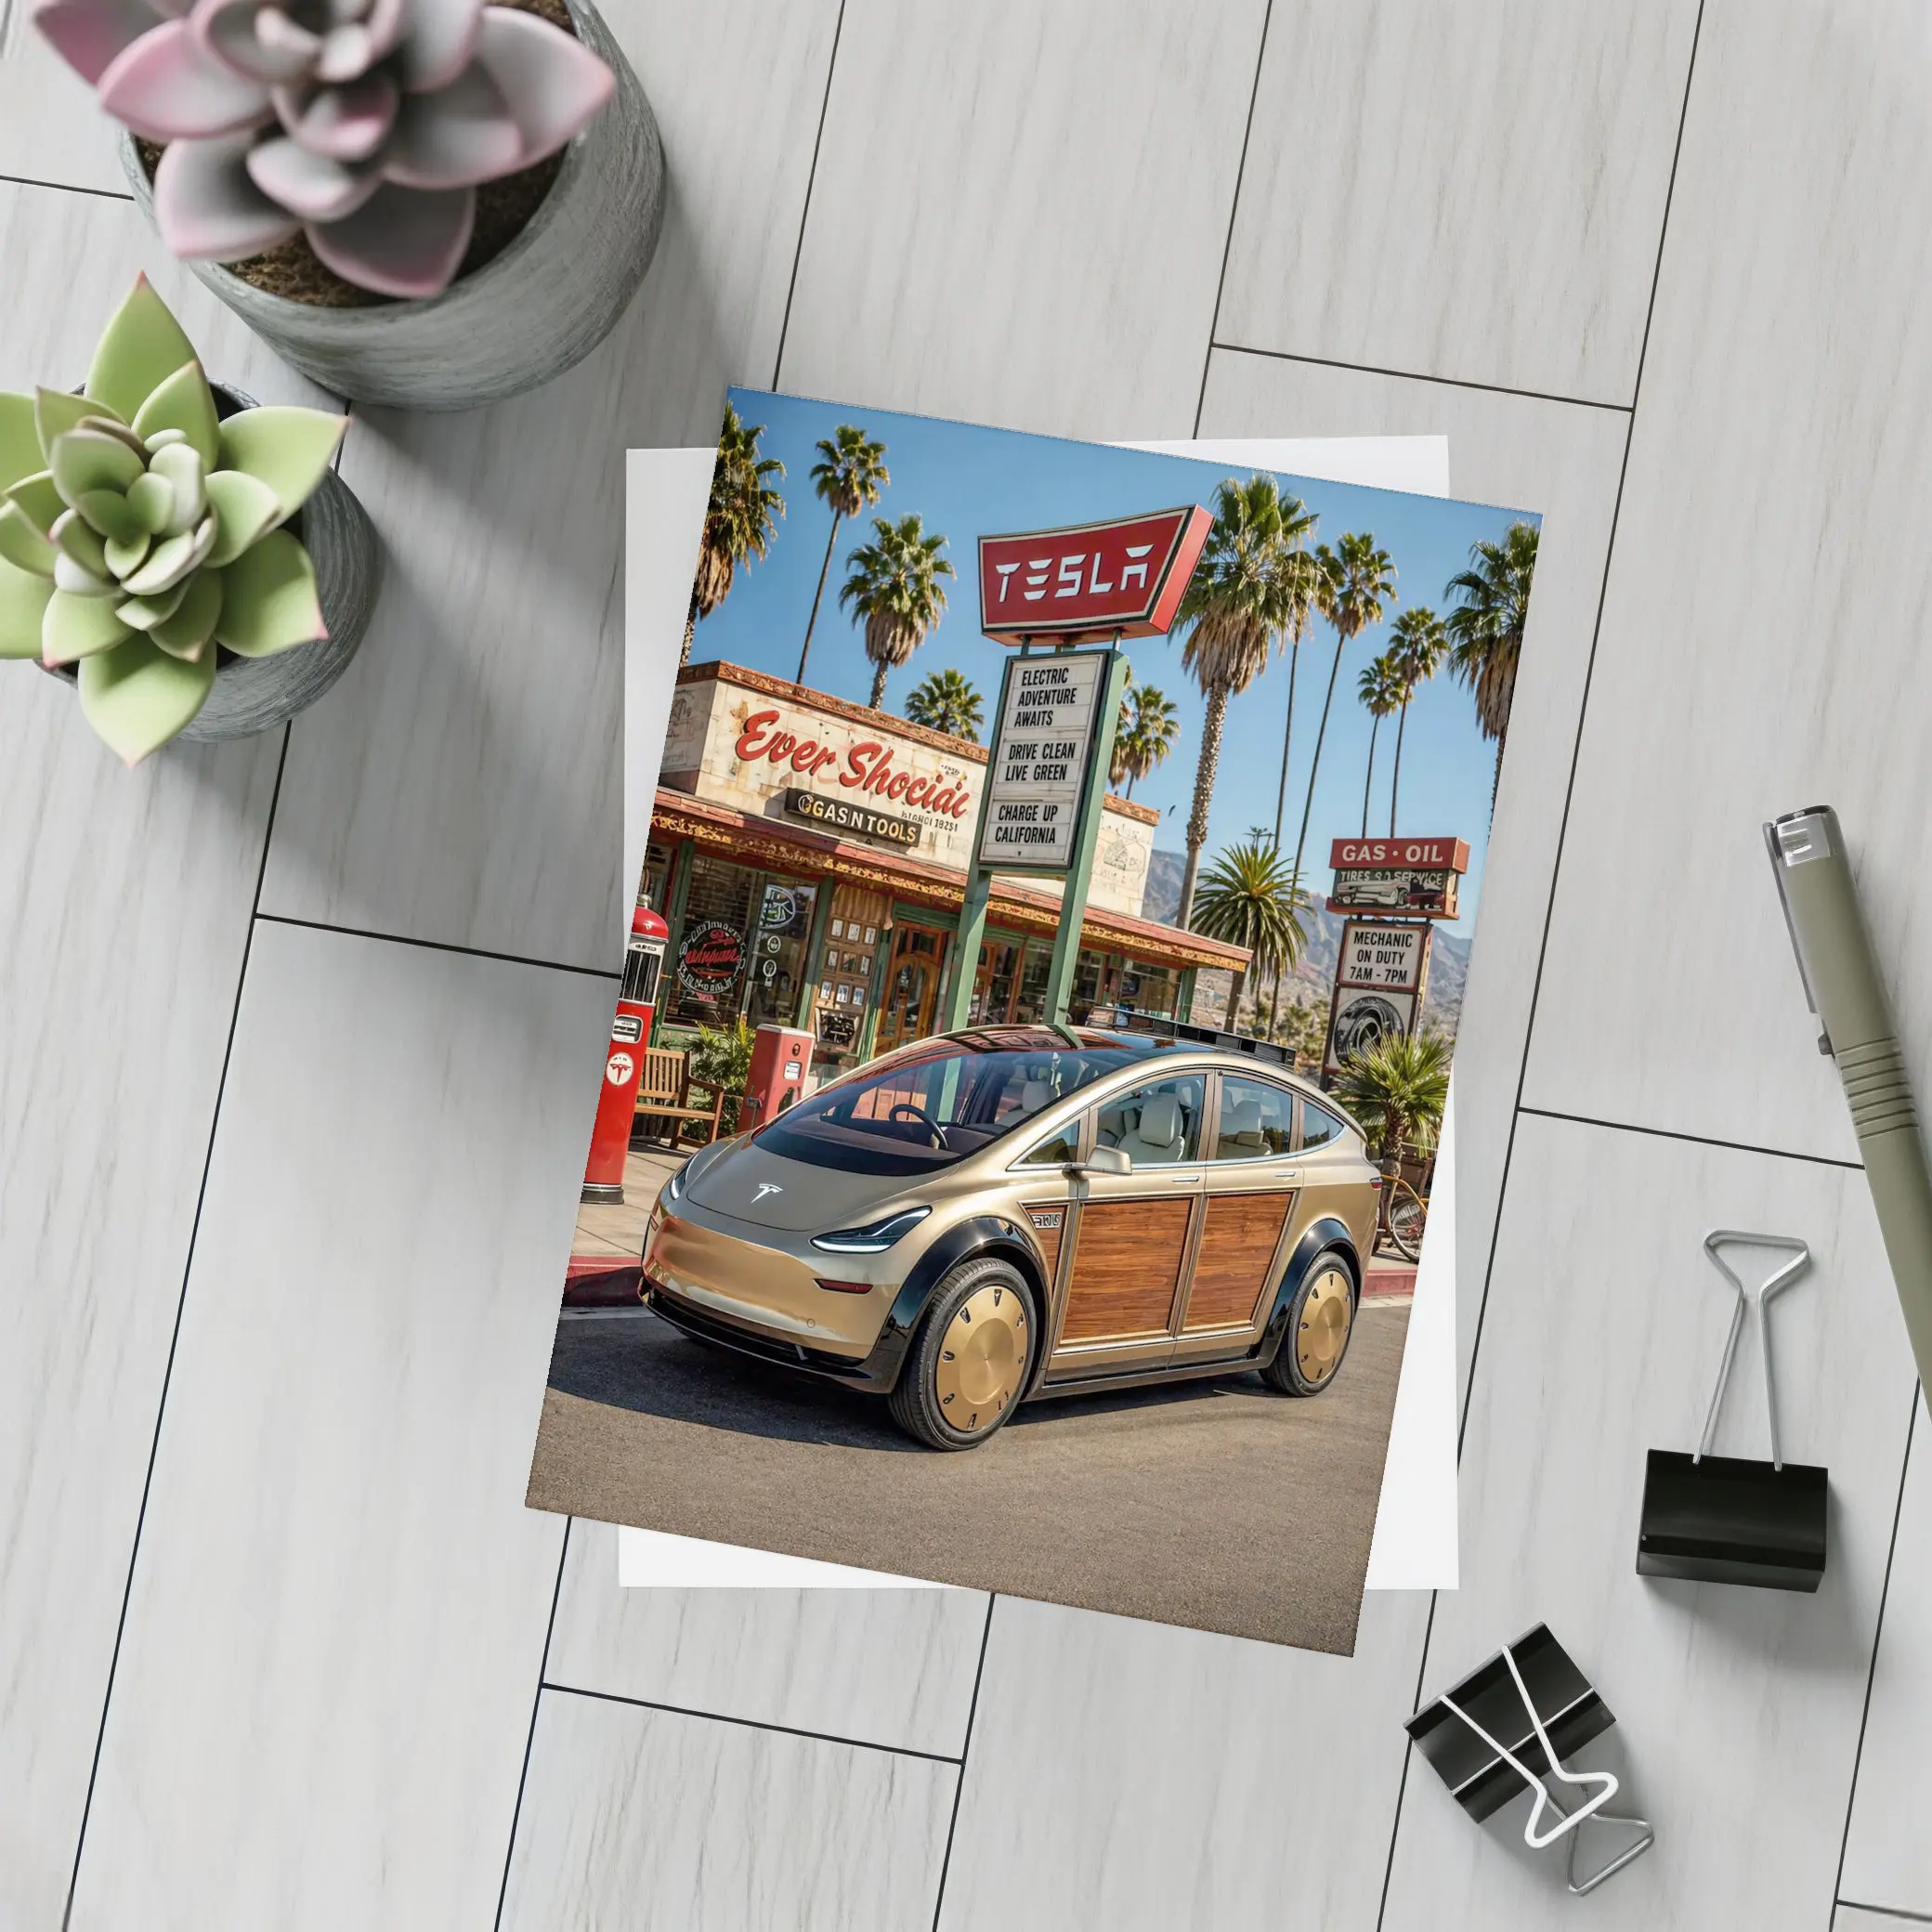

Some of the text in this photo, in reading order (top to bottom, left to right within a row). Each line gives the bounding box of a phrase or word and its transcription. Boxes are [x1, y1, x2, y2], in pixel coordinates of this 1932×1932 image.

[996, 544, 1154, 602] TESLA
[1022, 668, 1069, 686] ELECTRIC
[1018, 687, 1077, 706] ADVENTURE
[1014, 710, 1054, 727] AWAITS
[735, 710, 836, 777] Ever
[1009, 742, 1077, 760] DRIVE CLEAN
[1005, 764, 1068, 781] LIVE GREEN
[999, 804, 1059, 822] CHARGE UP
[867, 815, 918, 843] TOOLS
[995, 826, 1056, 843] CALIFORNIA
[1341, 844, 1387, 862] GAS
[1405, 844, 1443, 862] OIL
[1340, 870, 1371, 881] TIRES
[1353, 931, 1414, 947] MECHANIC
[1357, 949, 1405, 965] ON DUTY
[1350, 966, 1373, 981] 7AM
[1385, 969, 1408, 984] 7PM
